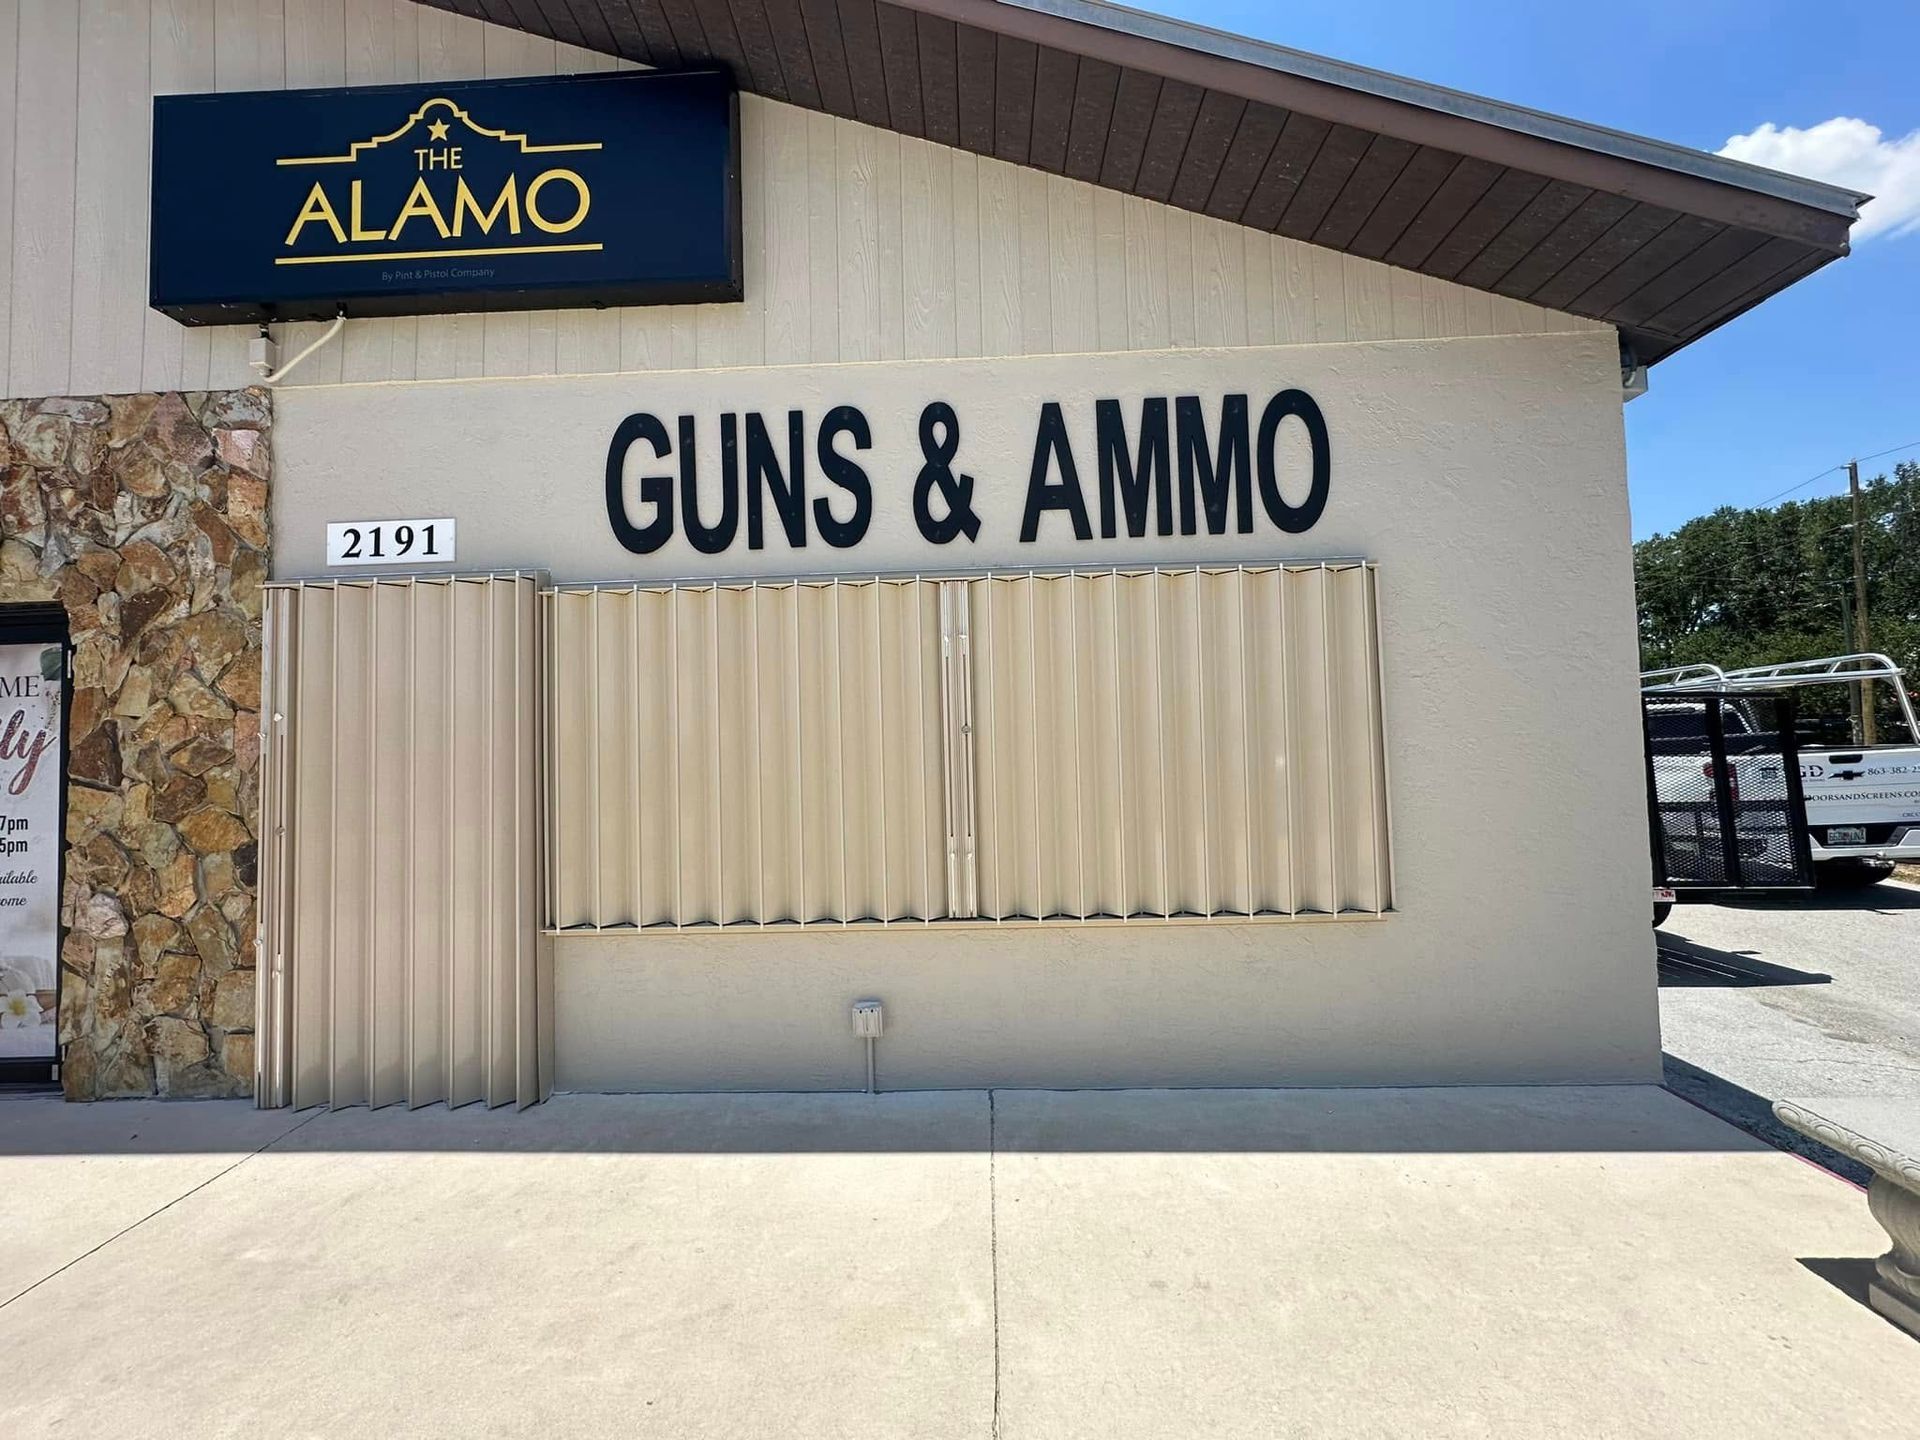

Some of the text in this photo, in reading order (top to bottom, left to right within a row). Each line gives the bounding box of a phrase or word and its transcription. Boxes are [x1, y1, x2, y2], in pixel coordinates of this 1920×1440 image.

[414, 147, 463, 171] THE
[285, 168, 591, 246] ALAMO
[382, 267, 495, 282] By Pint & Pistol Company
[605, 388, 1331, 554] GUNS & AMMO
[341, 524, 439, 559] 2191
[0, 675, 40, 698] ME
